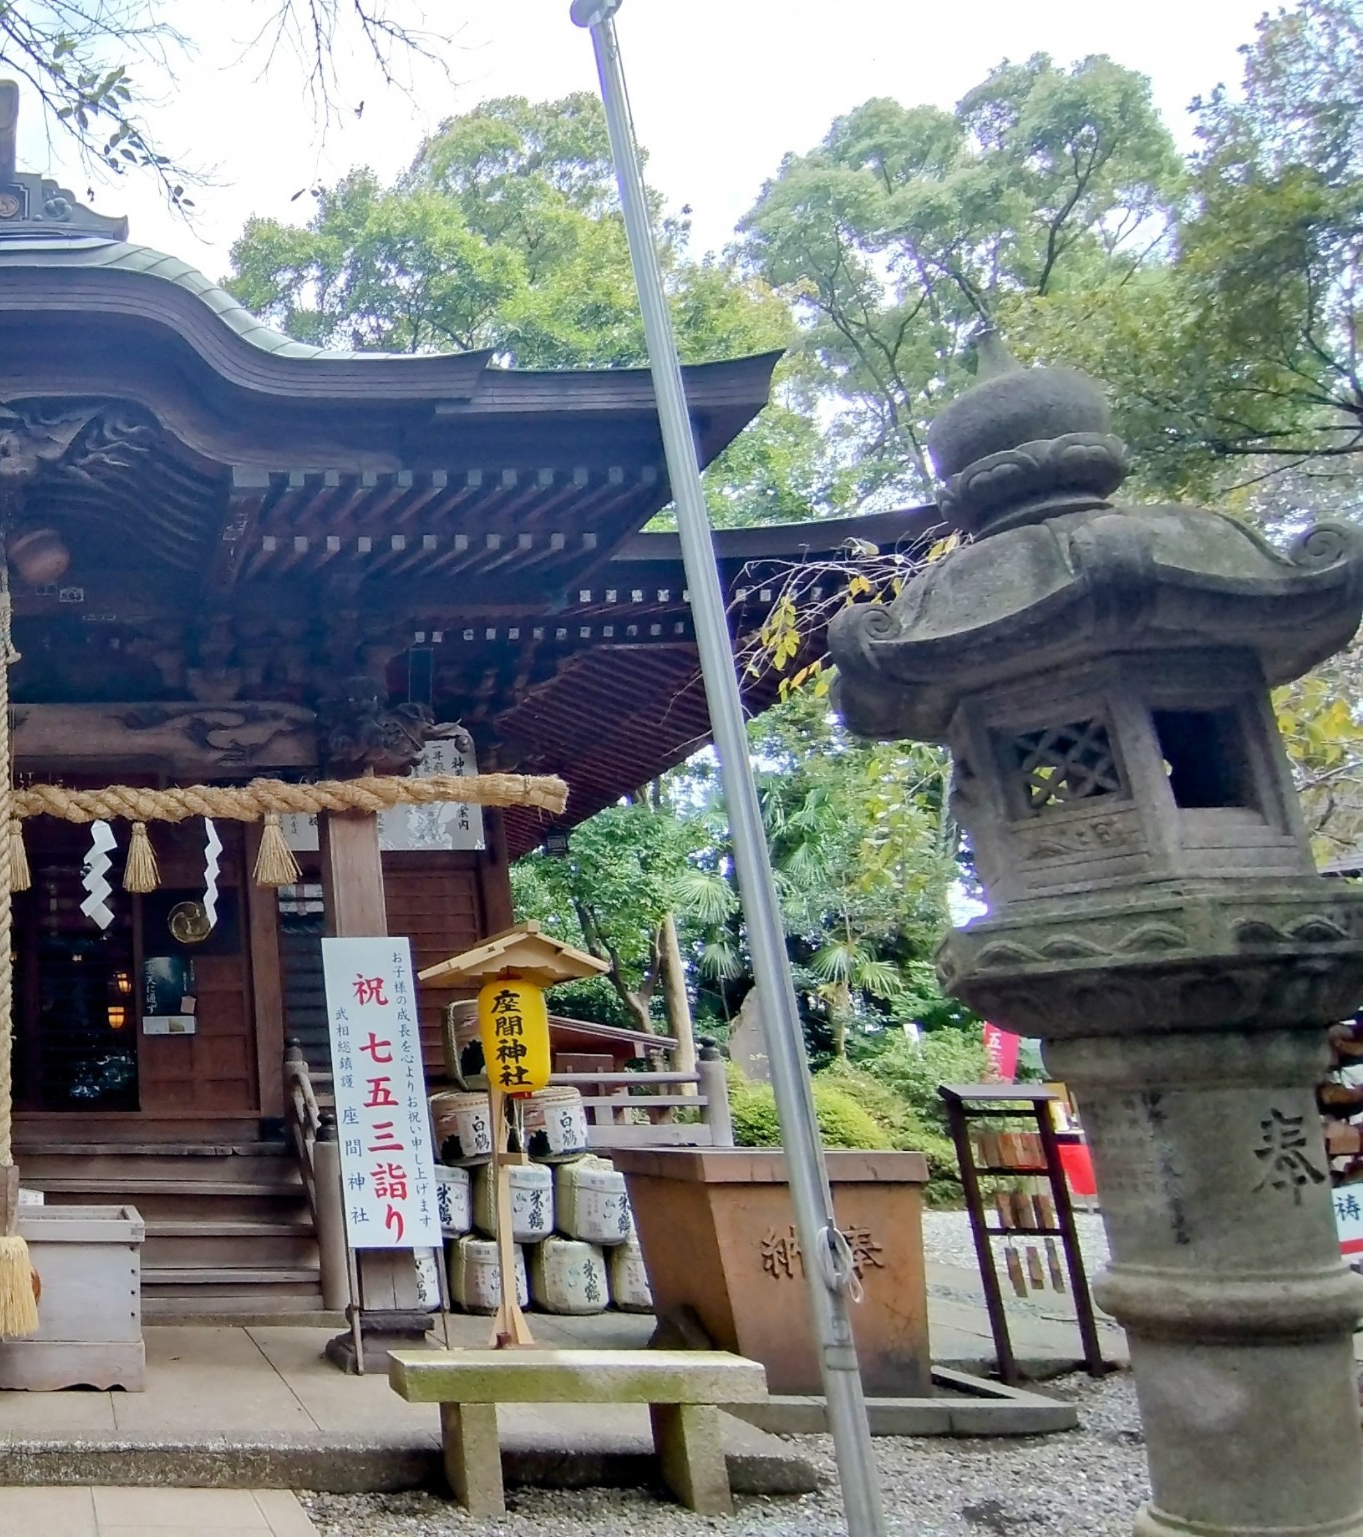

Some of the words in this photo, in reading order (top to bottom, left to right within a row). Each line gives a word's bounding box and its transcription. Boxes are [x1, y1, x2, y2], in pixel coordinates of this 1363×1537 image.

[352, 973, 389, 1006] 祝
[491, 989, 533, 1087] 座間神社
[358, 1032, 408, 1244] 七五三詣り
[392, 952, 432, 1228] お子様の成長を心よりお祝い申し上げます
[342, 1106, 370, 1225] 座間神社
